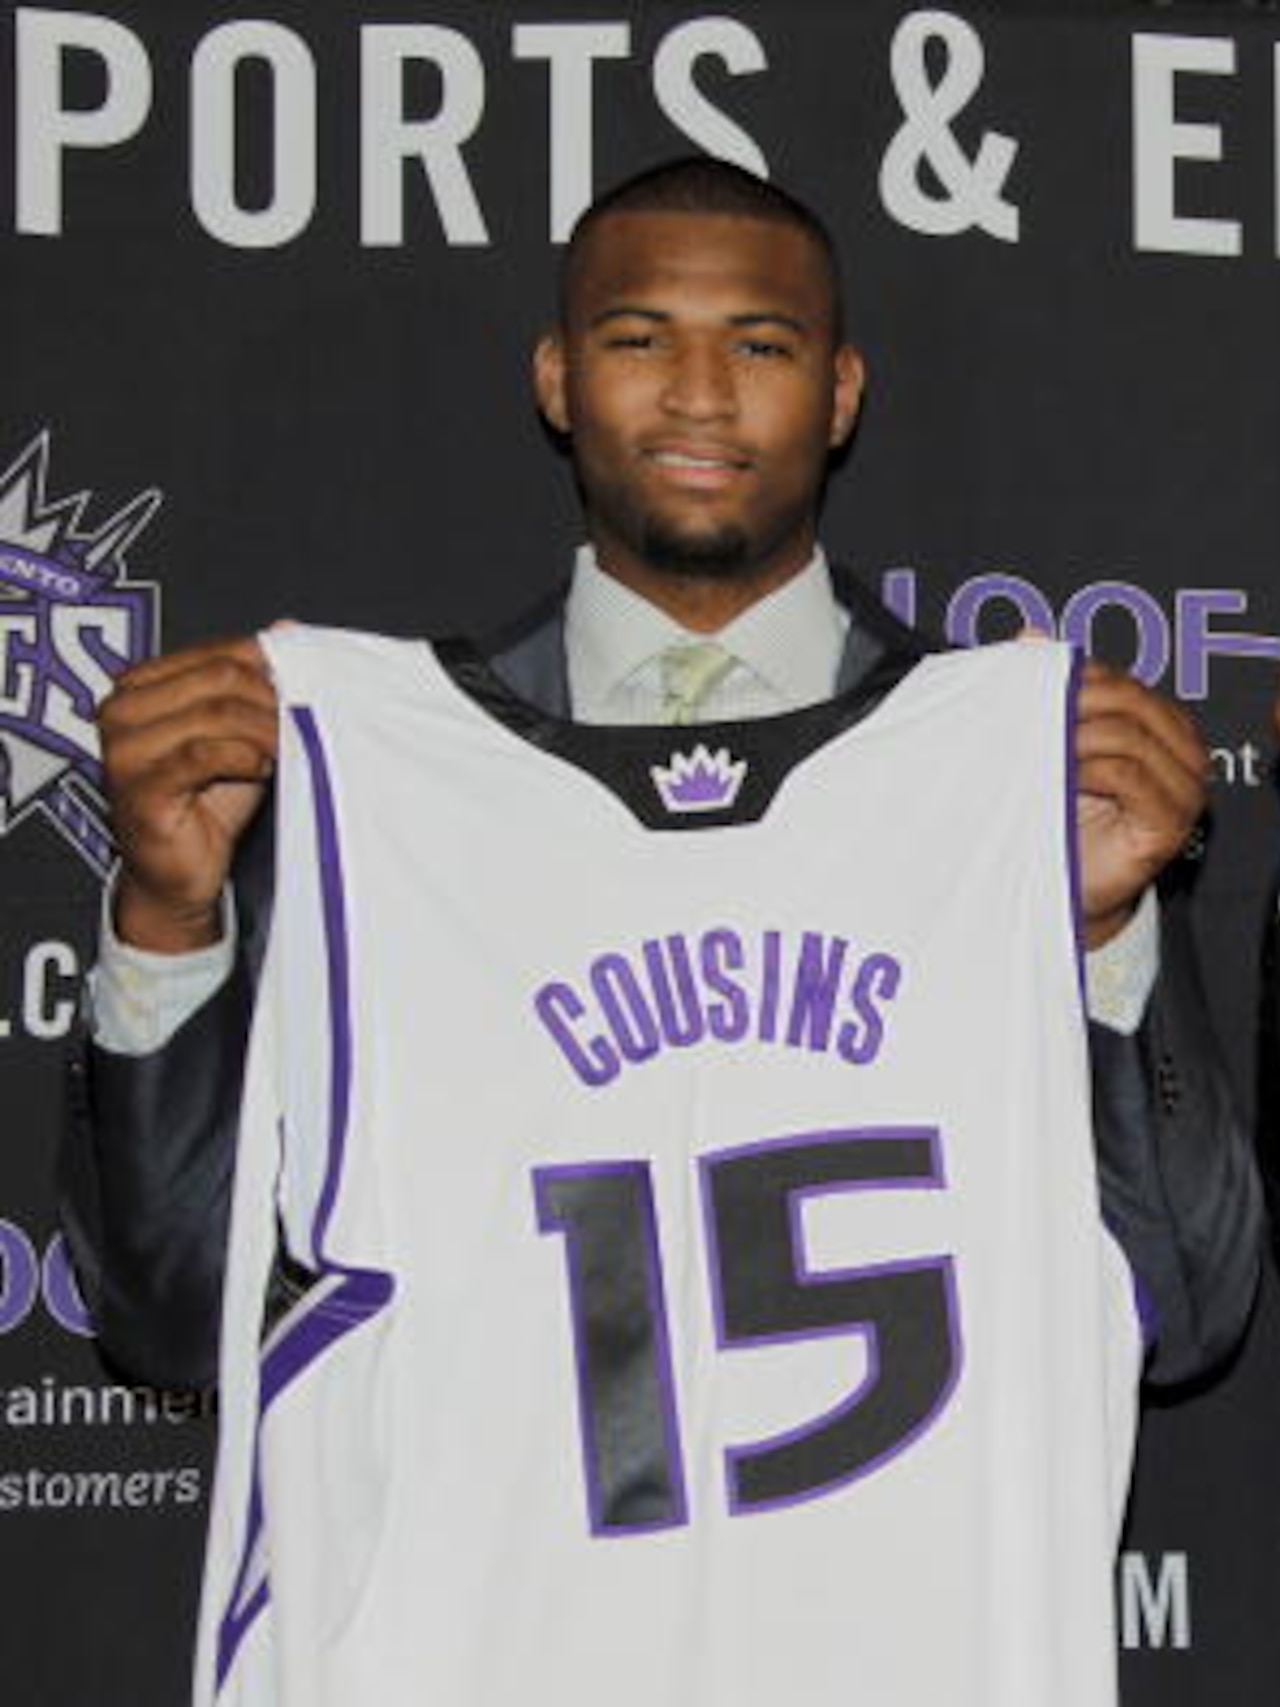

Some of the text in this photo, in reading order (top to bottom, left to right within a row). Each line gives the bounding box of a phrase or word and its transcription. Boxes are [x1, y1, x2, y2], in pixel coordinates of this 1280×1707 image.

[879, 9, 1020, 244] &
[533, 927, 902, 1087] COUSINS
[530, 1125, 965, 1539] 15
